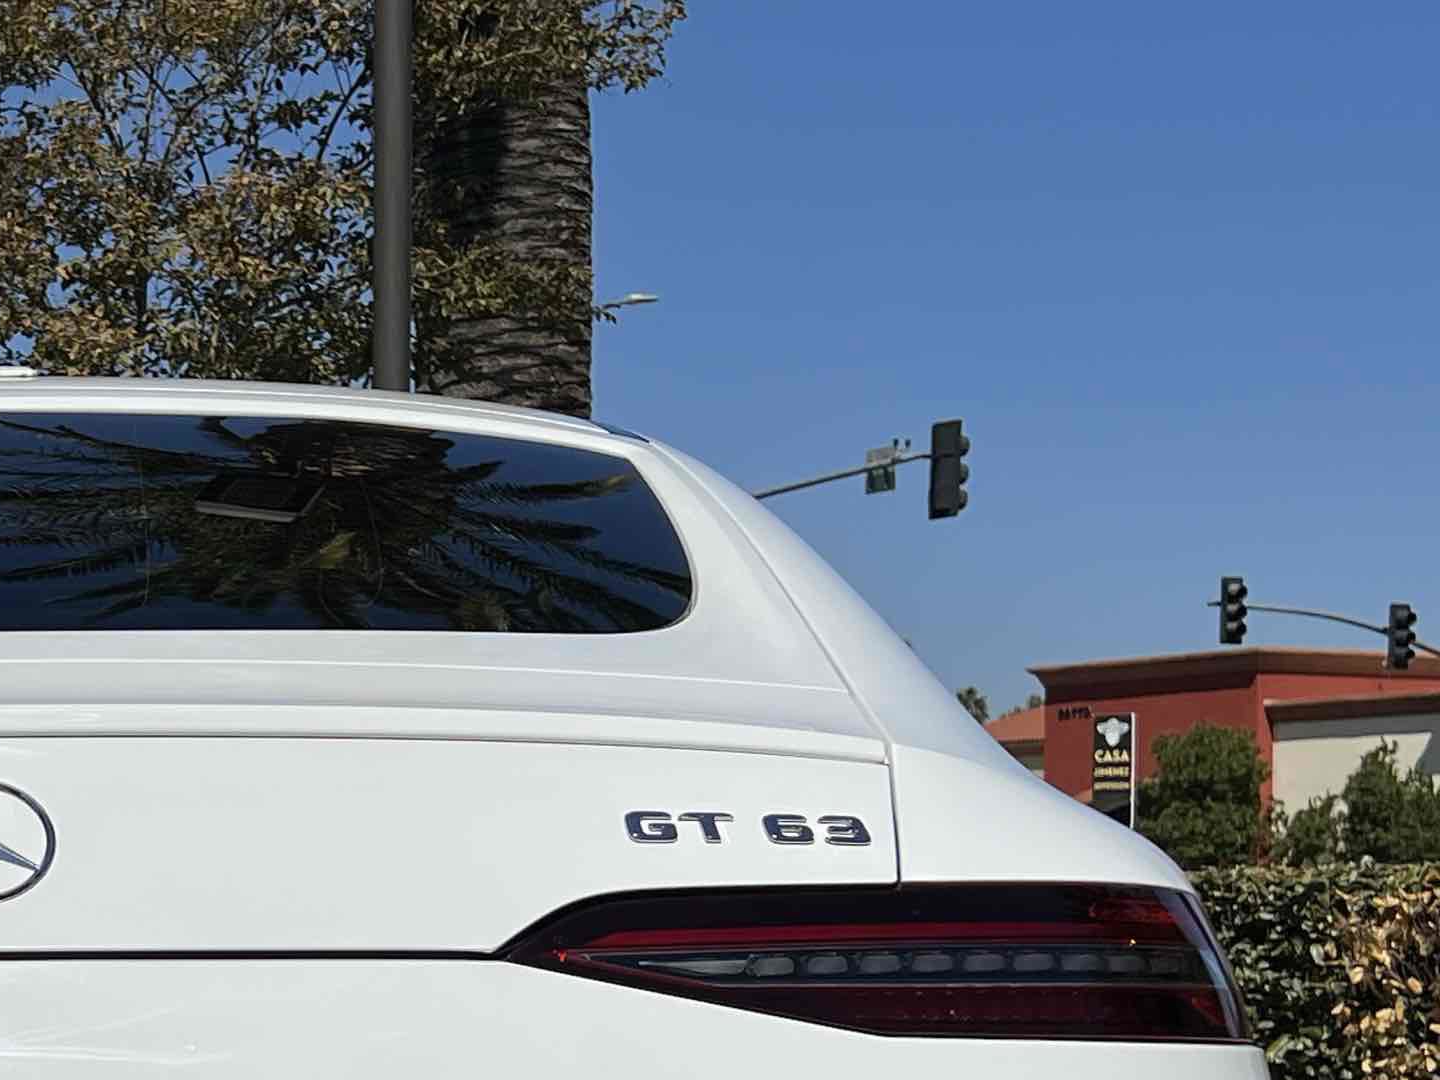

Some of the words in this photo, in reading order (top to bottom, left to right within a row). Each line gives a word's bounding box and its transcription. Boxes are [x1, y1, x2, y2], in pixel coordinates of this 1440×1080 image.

[1094, 749, 1130, 763] CASA
[623, 810, 735, 844] GT
[761, 813, 873, 846] 63
